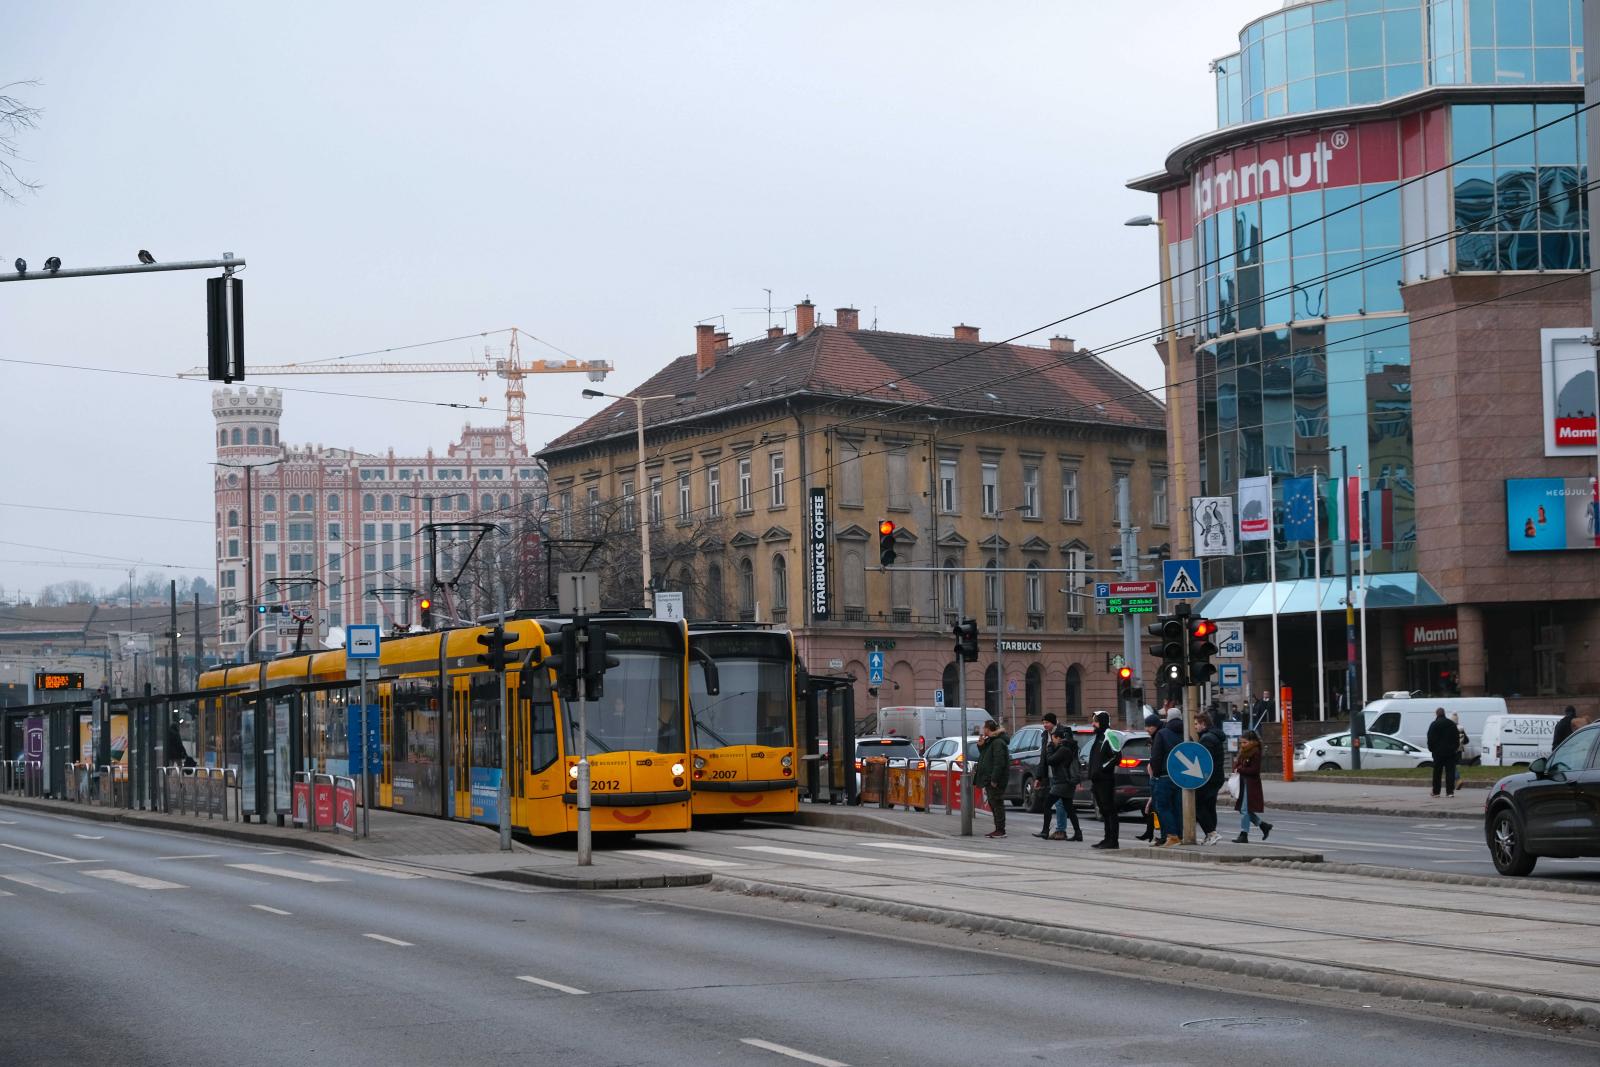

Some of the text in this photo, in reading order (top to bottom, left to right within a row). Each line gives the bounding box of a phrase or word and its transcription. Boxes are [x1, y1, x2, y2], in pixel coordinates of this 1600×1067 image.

[814, 495, 826, 613] STARBUCKS COFFEE
[1513, 719, 1558, 727] LAPTO
[712, 770, 737, 779] 2007
[591, 780, 620, 790] 2012
